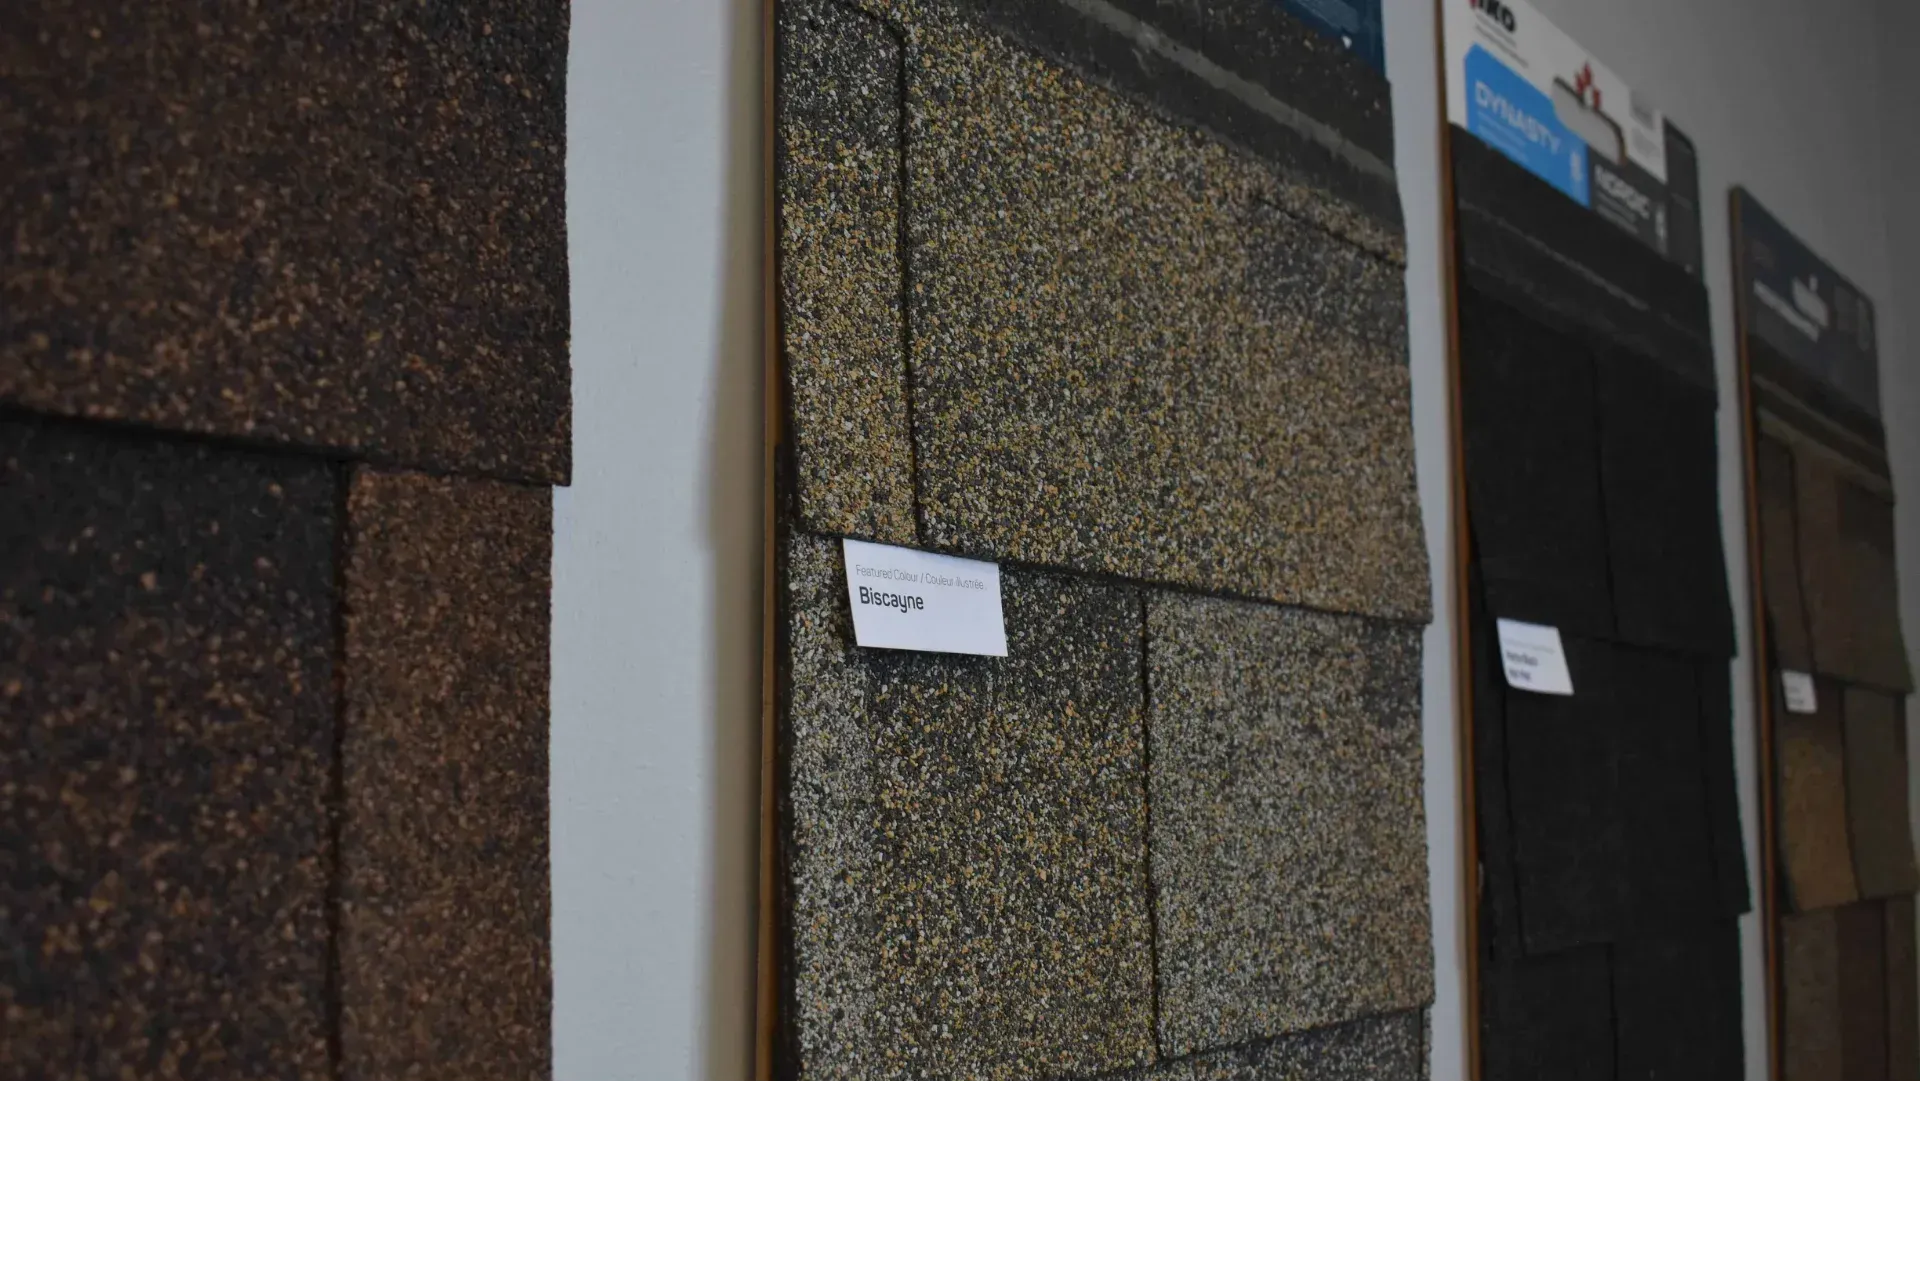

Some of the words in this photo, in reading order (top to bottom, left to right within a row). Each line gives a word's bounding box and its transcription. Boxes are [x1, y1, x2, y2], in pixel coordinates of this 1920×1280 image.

[1475, 80, 1562, 154] DYNASTY
[856, 564, 892, 580] Featured
[893, 569, 918, 583] Colour
[925, 573, 954, 587] Couleur
[859, 586, 924, 613] Biscayne
